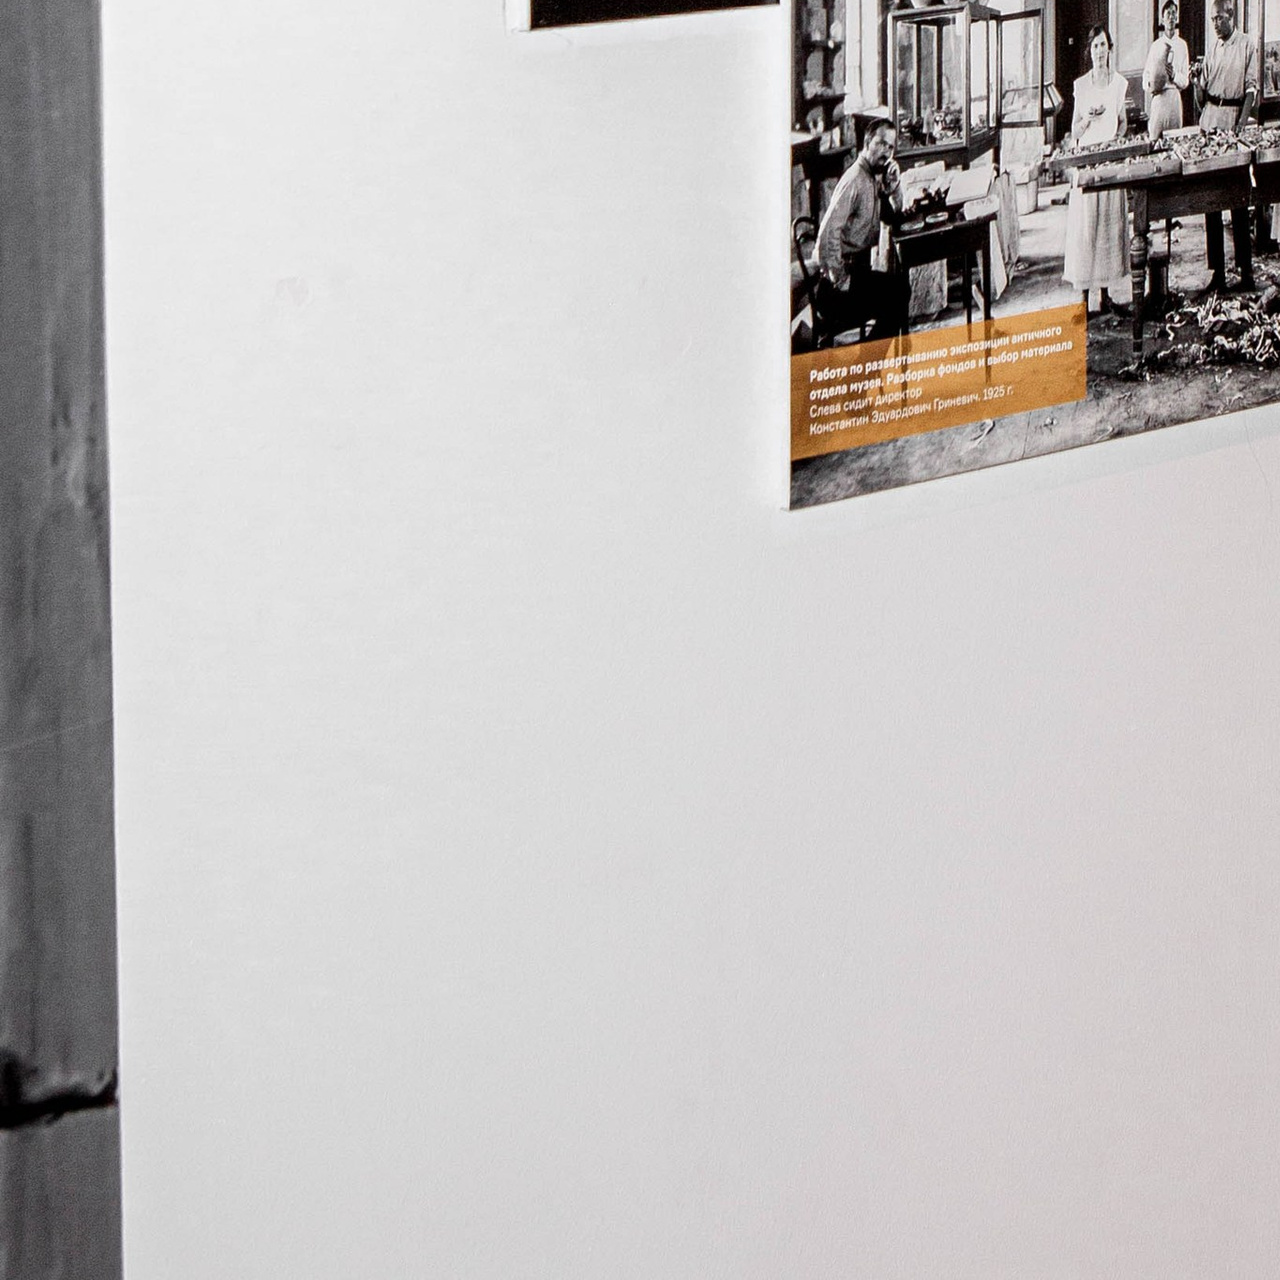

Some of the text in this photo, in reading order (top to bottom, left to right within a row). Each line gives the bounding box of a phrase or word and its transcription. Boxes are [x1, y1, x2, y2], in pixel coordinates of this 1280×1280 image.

[809, 326, 1062, 383] Работа по развертыванию экспозиции античного
[809, 384, 847, 401] отдела
[849, 378, 884, 393] музея.
[886, 367, 936, 385] Разборка
[937, 359, 976, 378] фондов
[987, 351, 1019, 365] выбор
[1020, 340, 1073, 359] материала
[809, 387, 922, 418] Слева сидит директор
[809, 416, 869, 435] Константин
[871, 403, 931, 423] Эдуардович
[982, 385, 1005, 401] 1925
